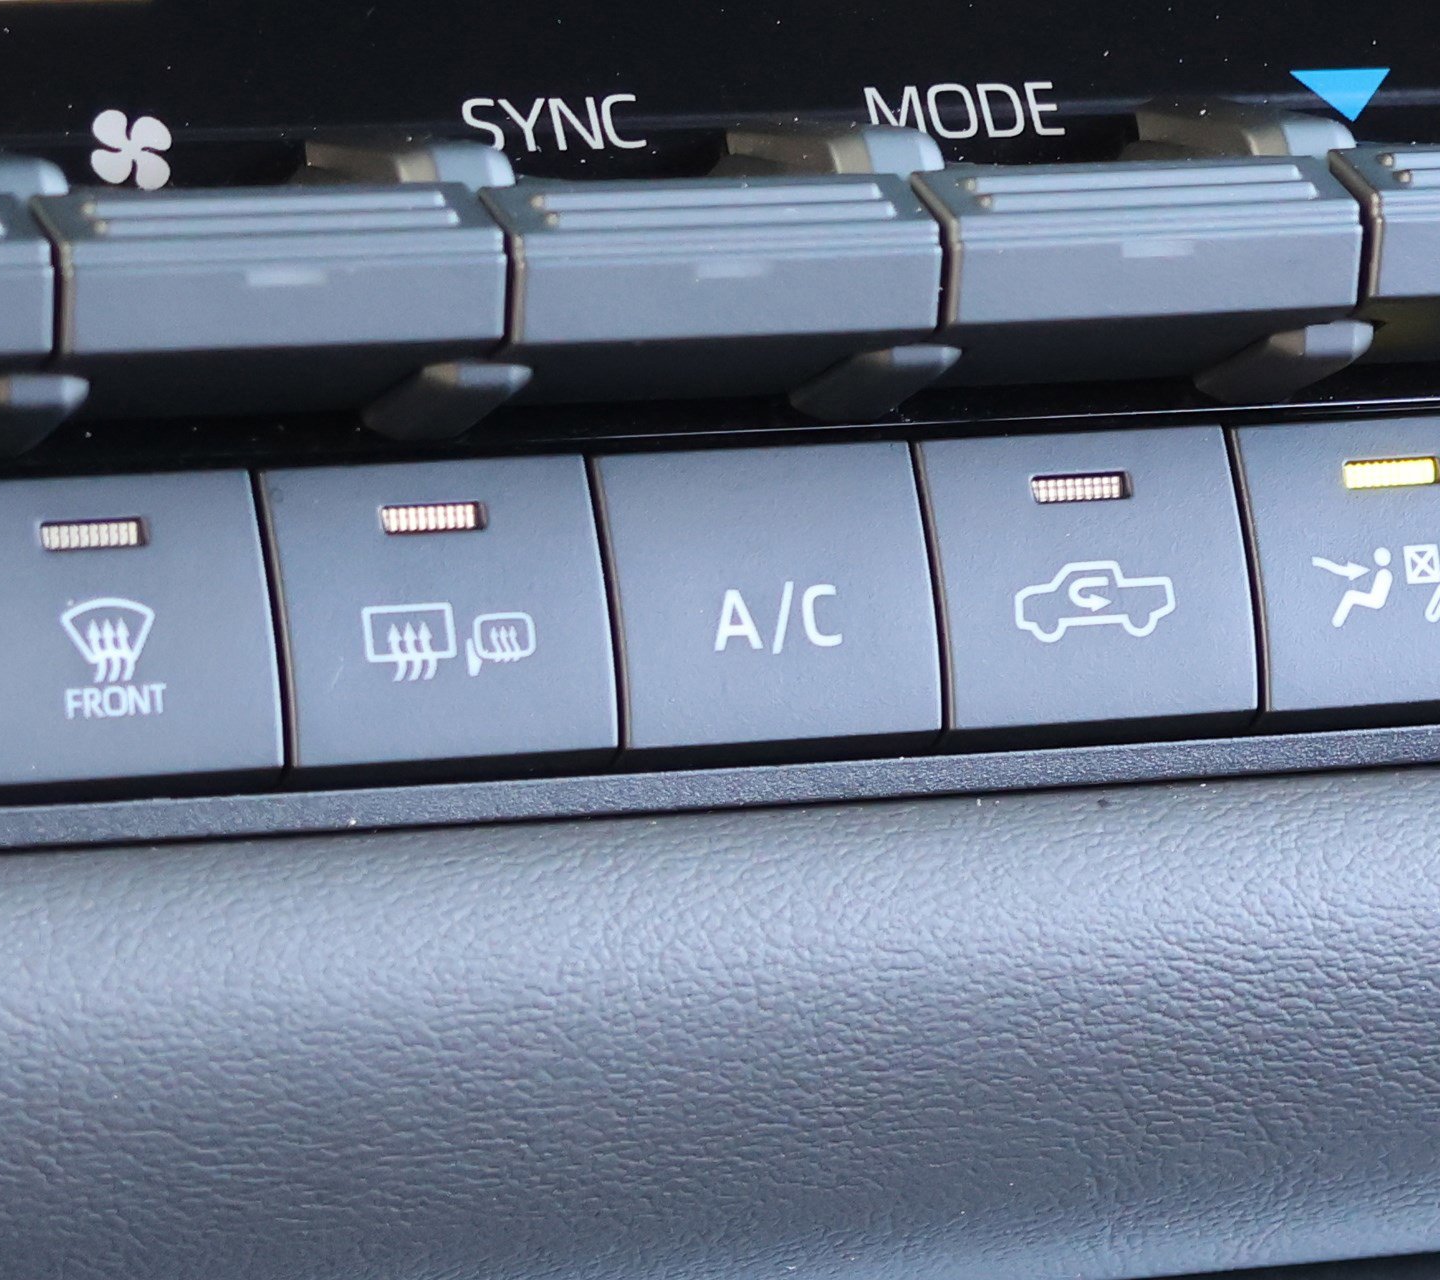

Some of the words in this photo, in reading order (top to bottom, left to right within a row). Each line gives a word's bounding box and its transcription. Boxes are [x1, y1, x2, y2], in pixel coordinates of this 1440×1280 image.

[462, 93, 647, 153] SYNC
[864, 81, 1066, 141] MODE
[714, 581, 843, 655] A/C
[65, 682, 167, 719] FRONT
